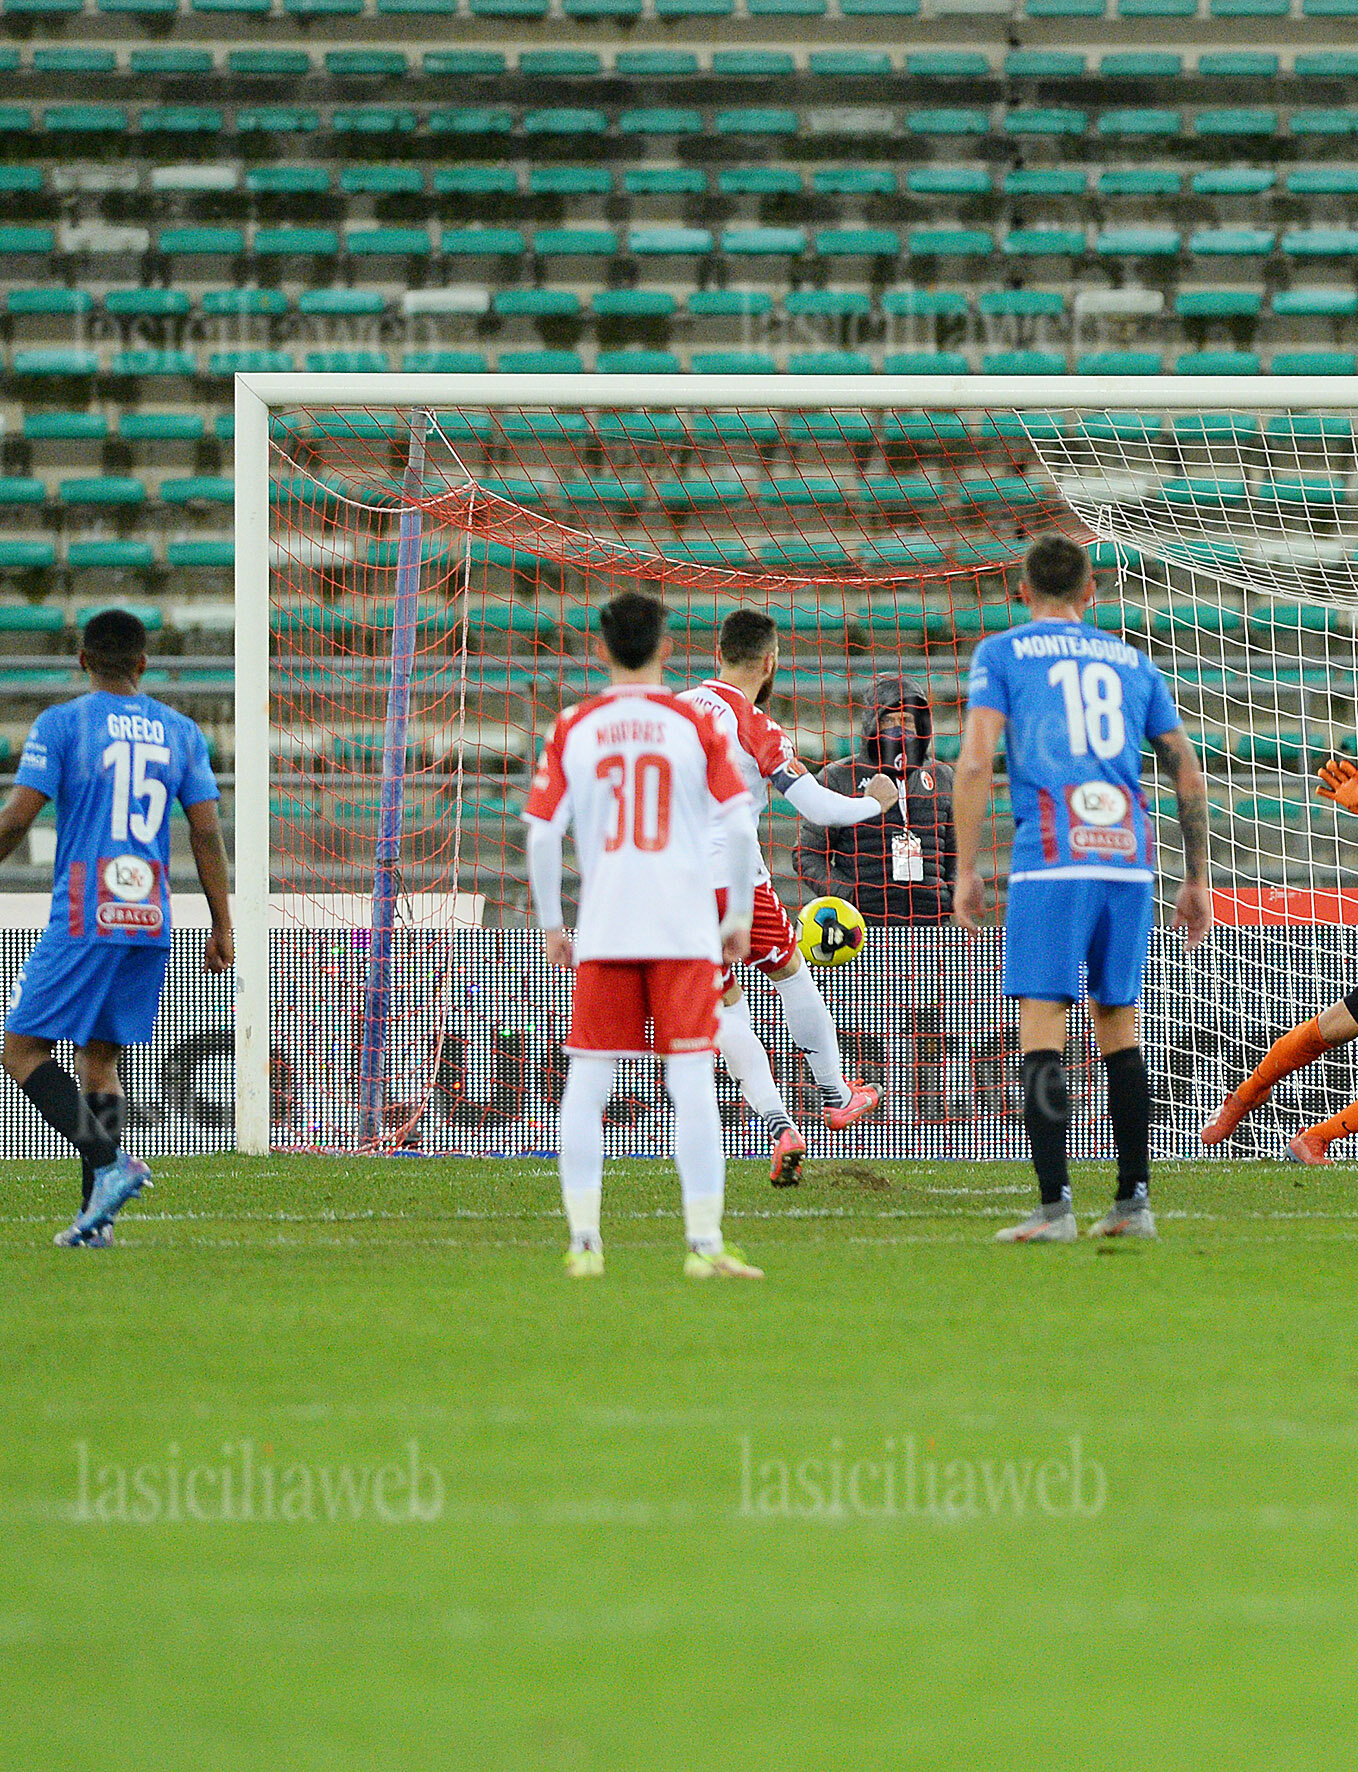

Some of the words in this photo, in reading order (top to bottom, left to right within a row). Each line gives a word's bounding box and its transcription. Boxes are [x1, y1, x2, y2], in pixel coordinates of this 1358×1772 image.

[1012, 634, 1140, 669] MONTEAGUDO
[107, 713, 165, 744] GRECO
[1048, 660, 1125, 759] 18
[103, 741, 170, 844] 15
[596, 753, 672, 853] 30
